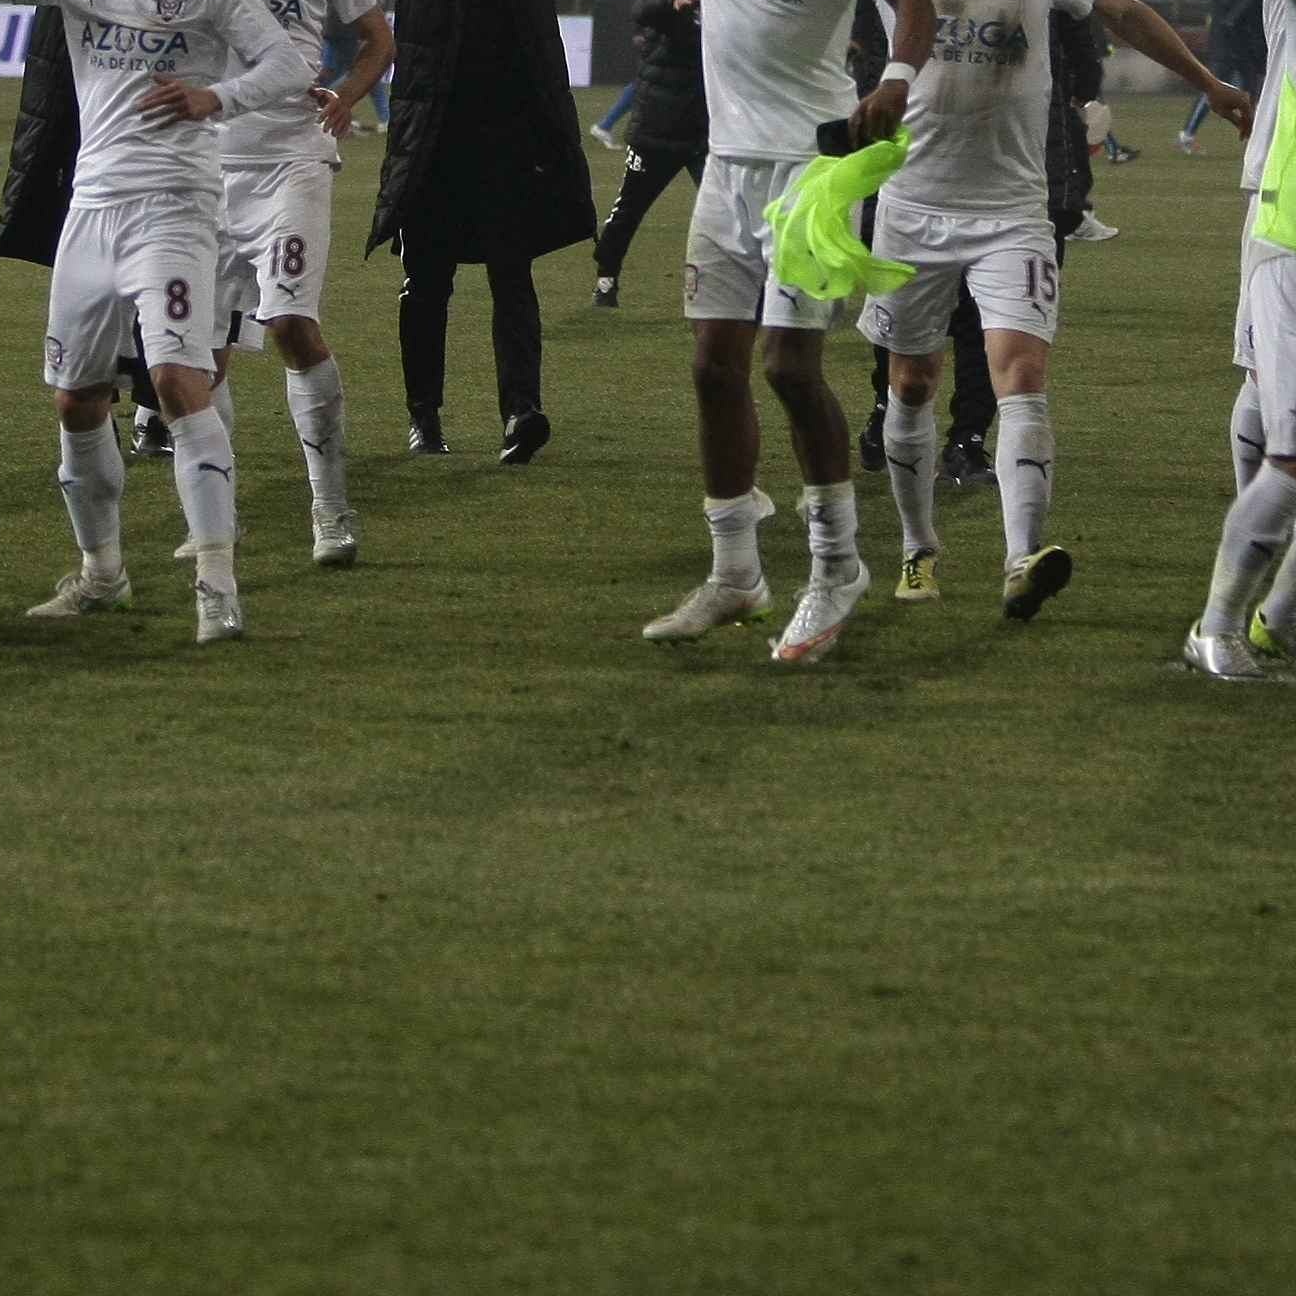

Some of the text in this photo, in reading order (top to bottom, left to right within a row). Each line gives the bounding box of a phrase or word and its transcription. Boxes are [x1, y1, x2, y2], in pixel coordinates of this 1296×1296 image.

[81, 21, 189, 55] AZUGA
[935, 17, 1029, 50] ZUGA
[109, 57, 125, 70] DE
[270, 236, 306, 279] 18
[1026, 258, 1057, 303] 15
[165, 278, 191, 322] 8
